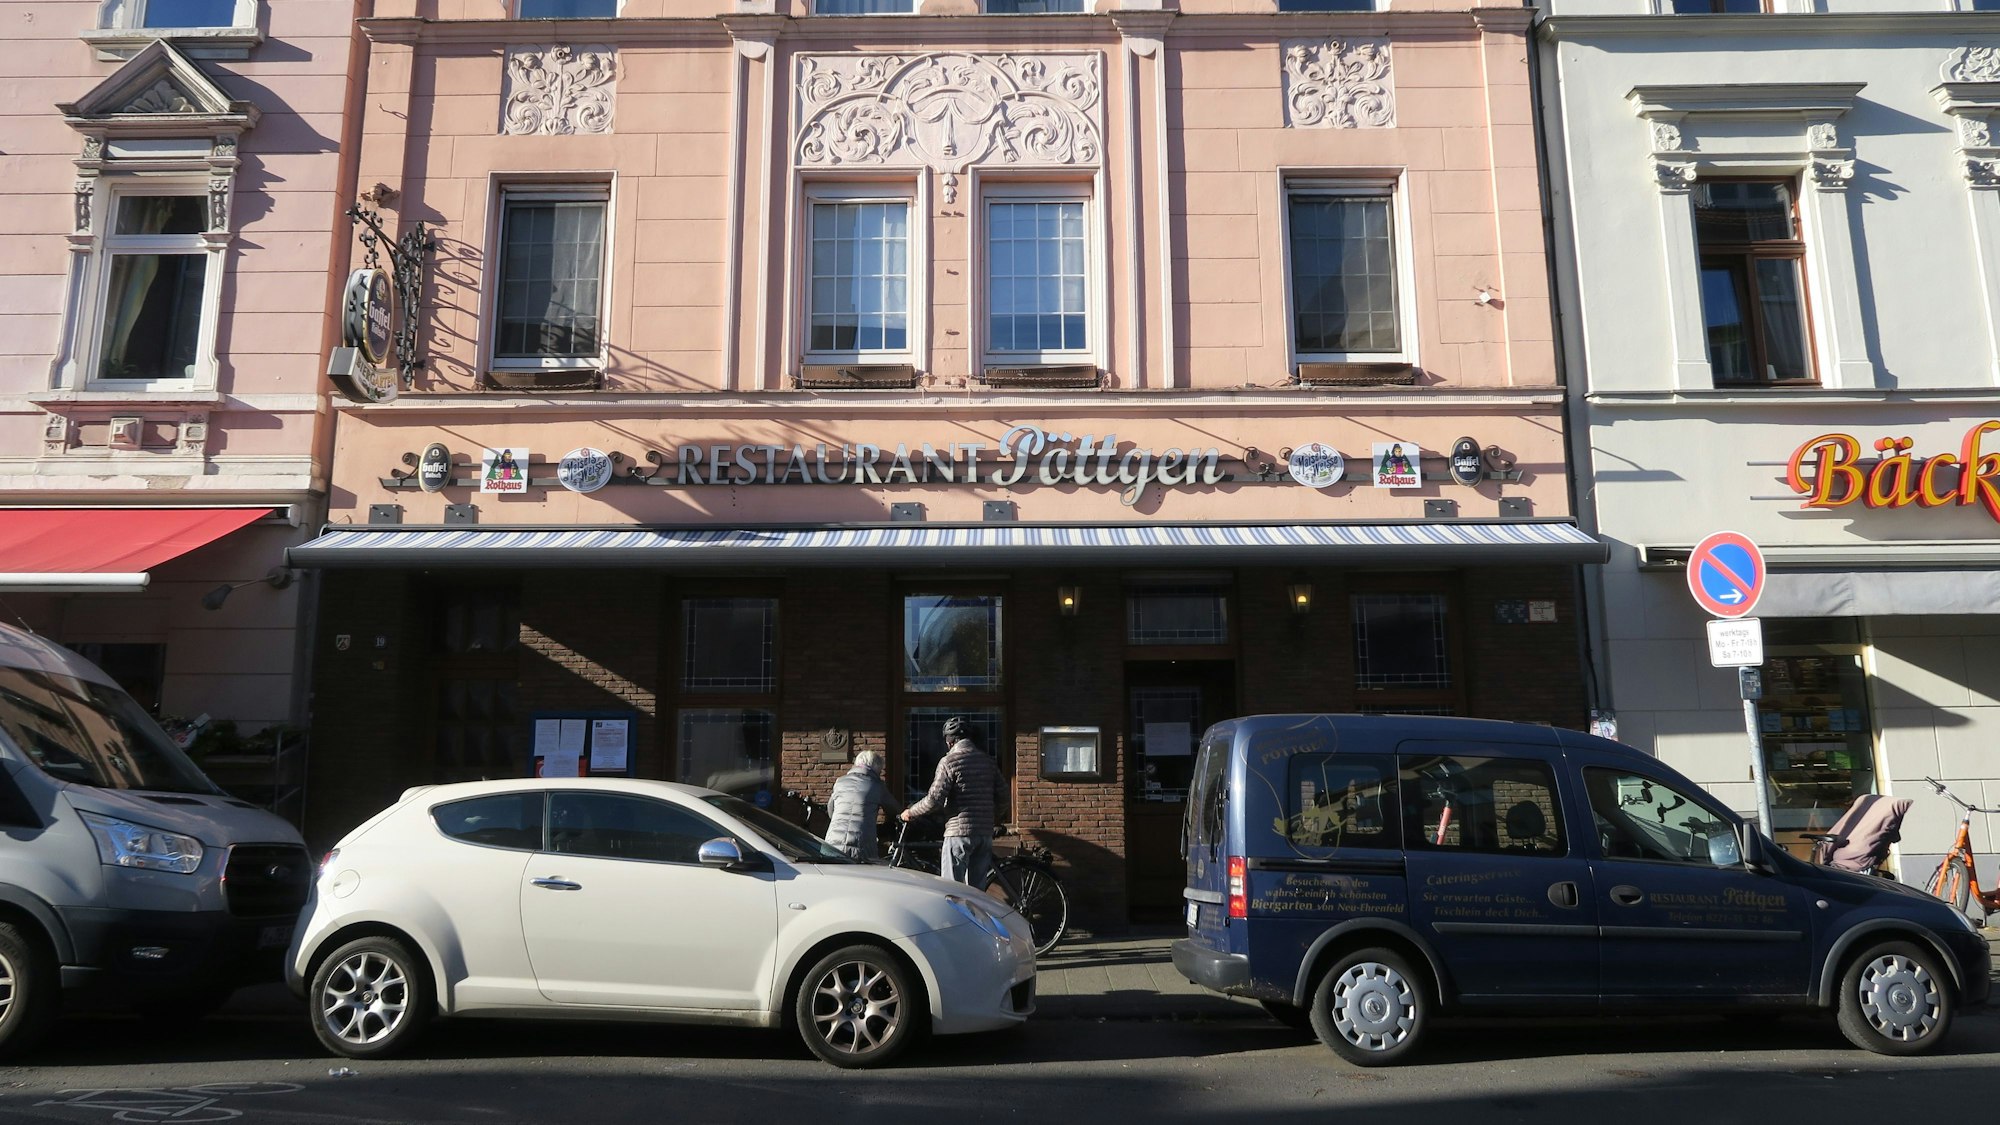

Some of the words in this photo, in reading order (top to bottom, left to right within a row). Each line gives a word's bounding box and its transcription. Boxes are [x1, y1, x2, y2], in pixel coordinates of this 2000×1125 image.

[369, 300, 391, 331] Gaffel
[355, 356, 397, 389] BIERGARTEN
[422, 461, 447, 473] Gaffel
[677, 442, 987, 486] RESTAURANT
[991, 424, 1225, 507] Pöttgen
[1454, 456, 1480, 467] Gaffel
[485, 478, 523, 492] Rothaus
[1378, 473, 1416, 486] Rothaus
[1720, 628, 1749, 638] werktags
[376, 637, 385, 647] 19
[1715, 640, 1726, 648] Mo
[1722, 650, 1731, 659] Sa
[1286, 876, 1332, 887] Besuchen
[1352, 878, 1369, 888] den
[1426, 869, 1521, 887] Cateringservice
[1423, 891, 1438, 902] Sie
[1443, 894, 1491, 903] erwarten
[1650, 893, 1719, 904] RESTAURANT
[1722, 887, 1786, 912] Pöttgen
[1251, 899, 1313, 913] Biergarten
[1338, 903, 1404, 913] Neu-Ehrenfeld
[1434, 906, 1481, 917] Tischlein
[1486, 907, 1510, 917] deck
[1668, 911, 1703, 922] Telefon
